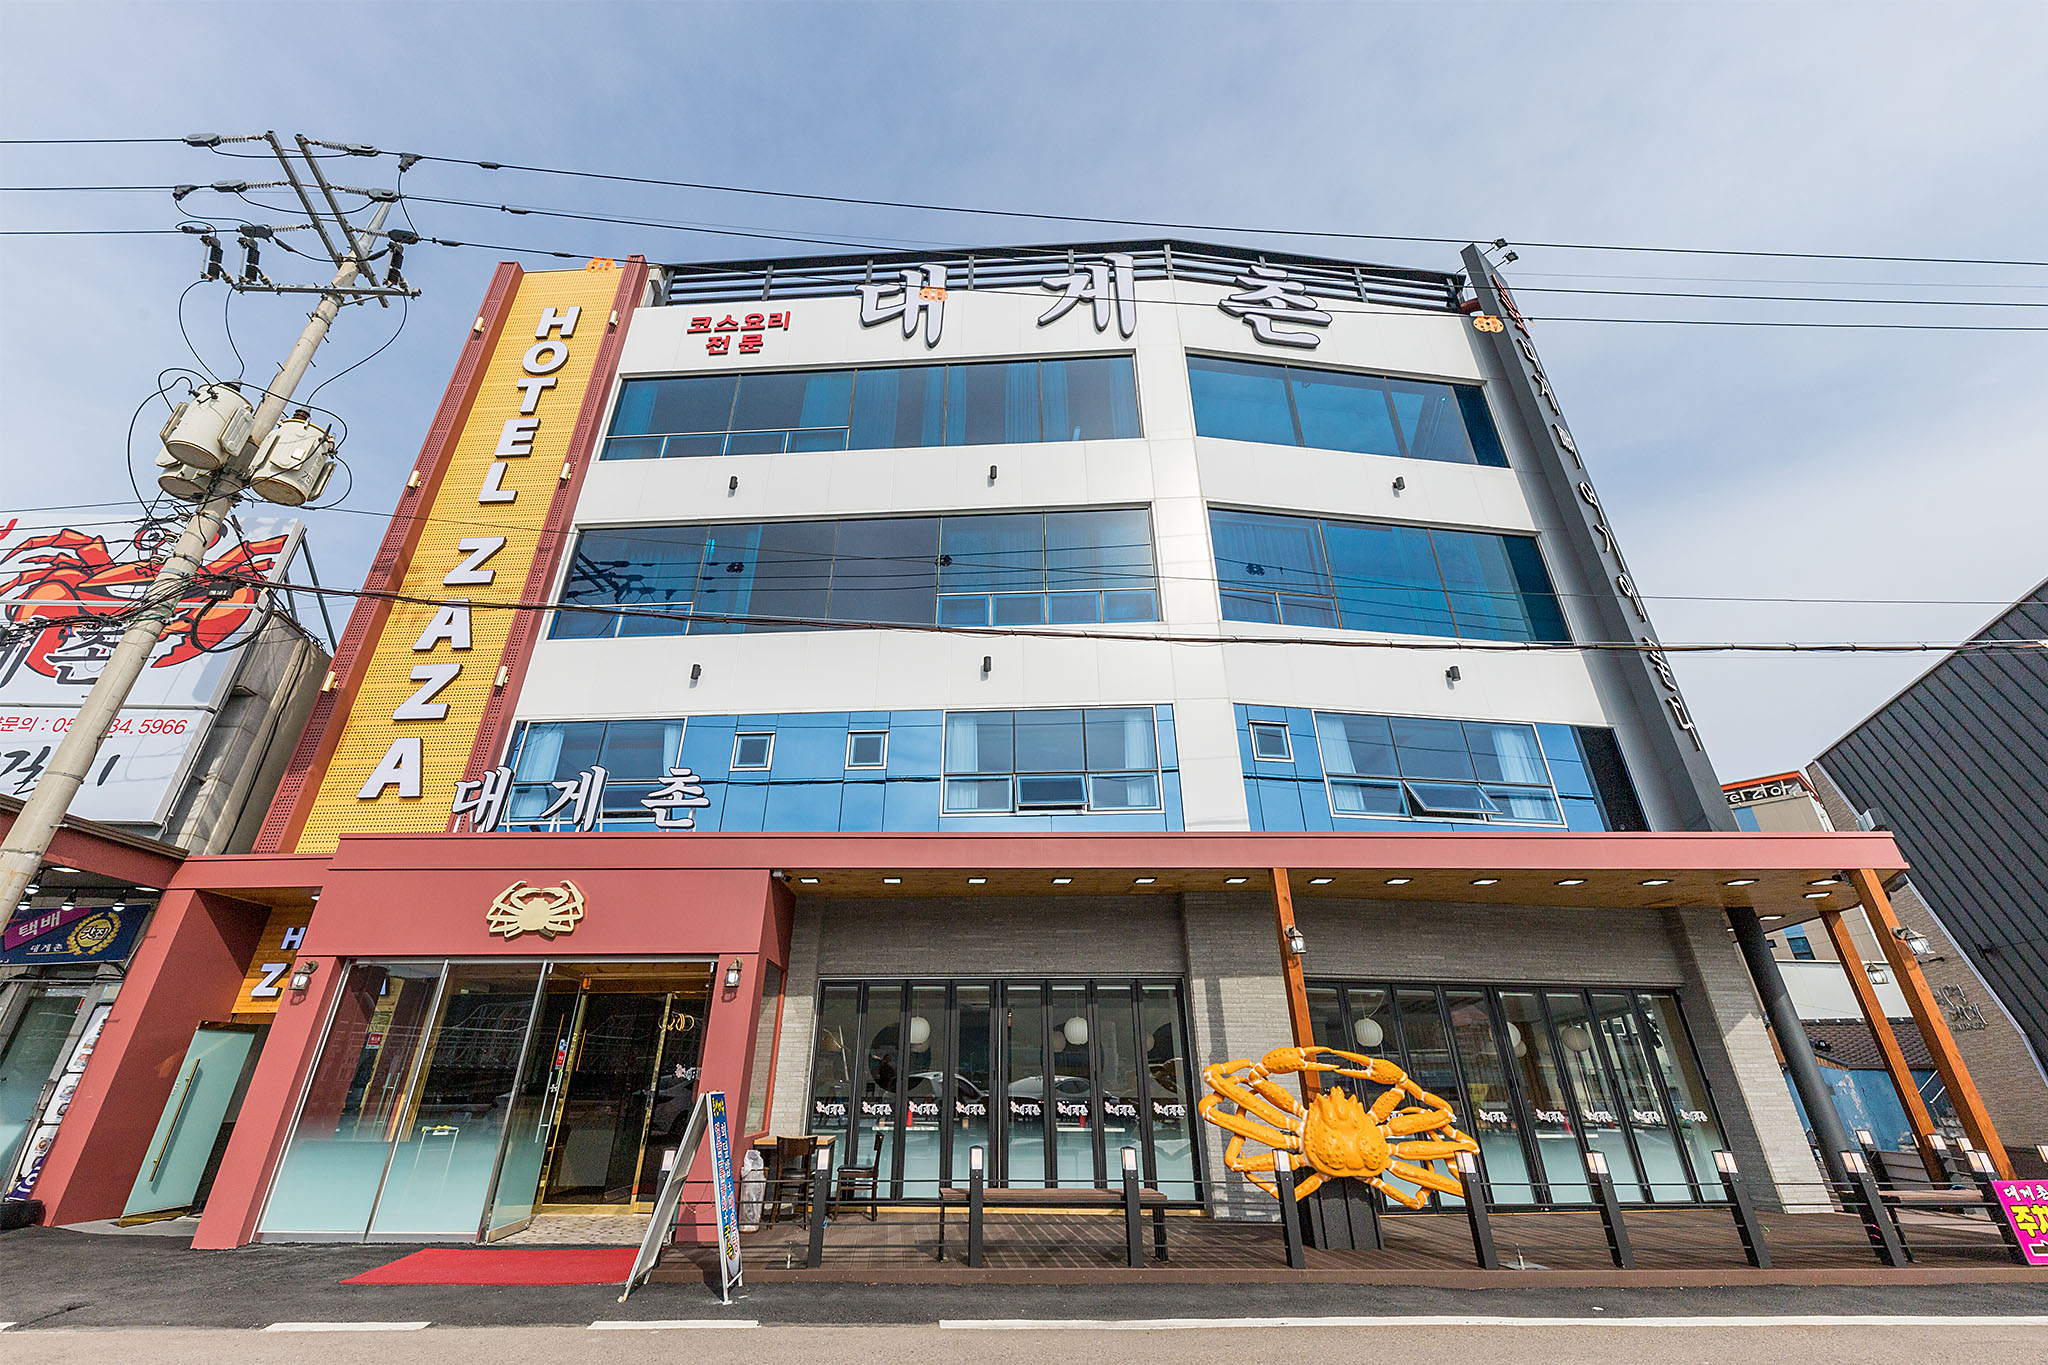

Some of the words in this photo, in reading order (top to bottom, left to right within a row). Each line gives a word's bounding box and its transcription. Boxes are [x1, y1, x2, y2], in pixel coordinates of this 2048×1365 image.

[855, 251, 1333, 349] 대게촌
[687, 311, 791, 334] 코스요리
[706, 333, 764, 356] 전문
[477, 305, 582, 504] HOTEL
[355, 536, 507, 801] ZAZA
[0, 716, 39, 732] 문의
[52, 717, 188, 735] 0534.5966
[452, 765, 711, 832] 대게촌
[19, 910, 61, 938] 택배
[80, 926, 109, 940] 맛집
